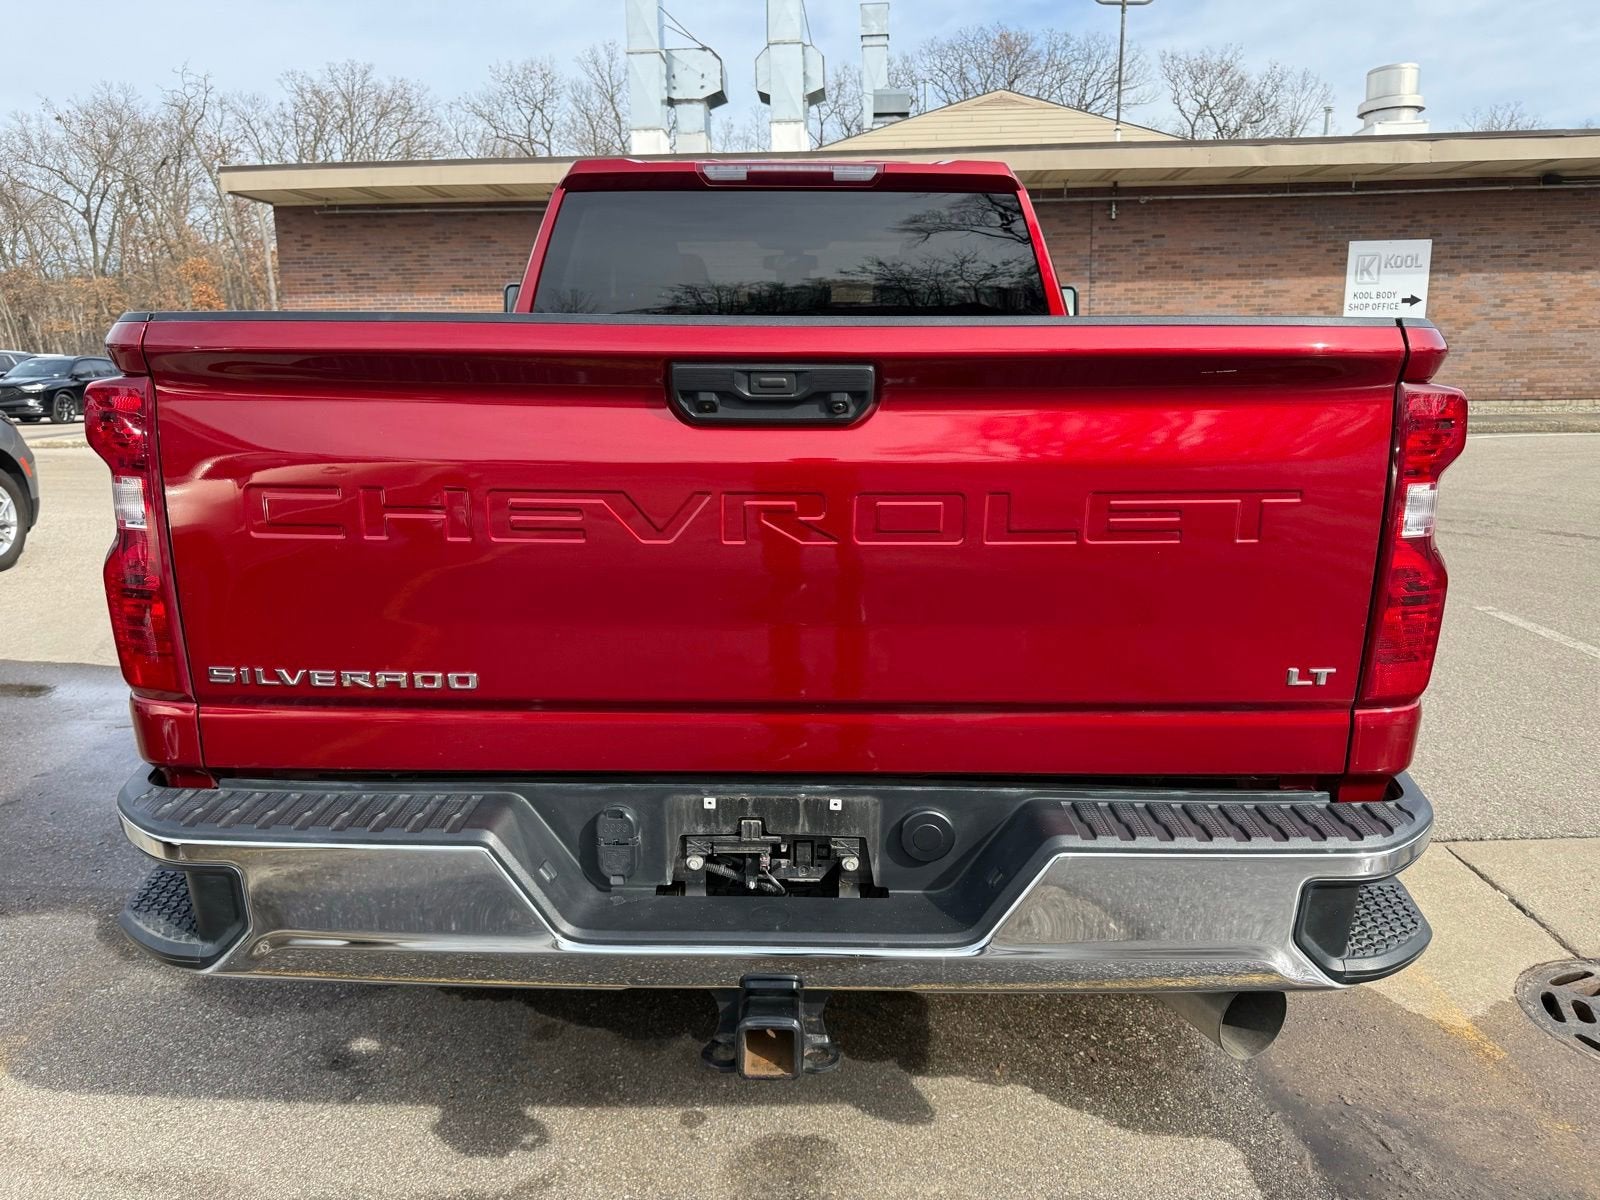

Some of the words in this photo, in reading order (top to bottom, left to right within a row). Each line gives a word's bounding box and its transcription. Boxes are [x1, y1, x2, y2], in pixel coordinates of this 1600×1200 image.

[1358, 255, 1378, 281] K
[1384, 253, 1423, 269] KOOL
[1353, 292, 1374, 300] KOOL
[1375, 291, 1397, 299] BODY
[1348, 303, 1370, 311] SHOP
[1371, 302, 1400, 311] OFFICE
[244, 483, 1302, 546] CHEVROLET
[207, 665, 478, 690] SILVERADO
[1287, 667, 1337, 686] LT
